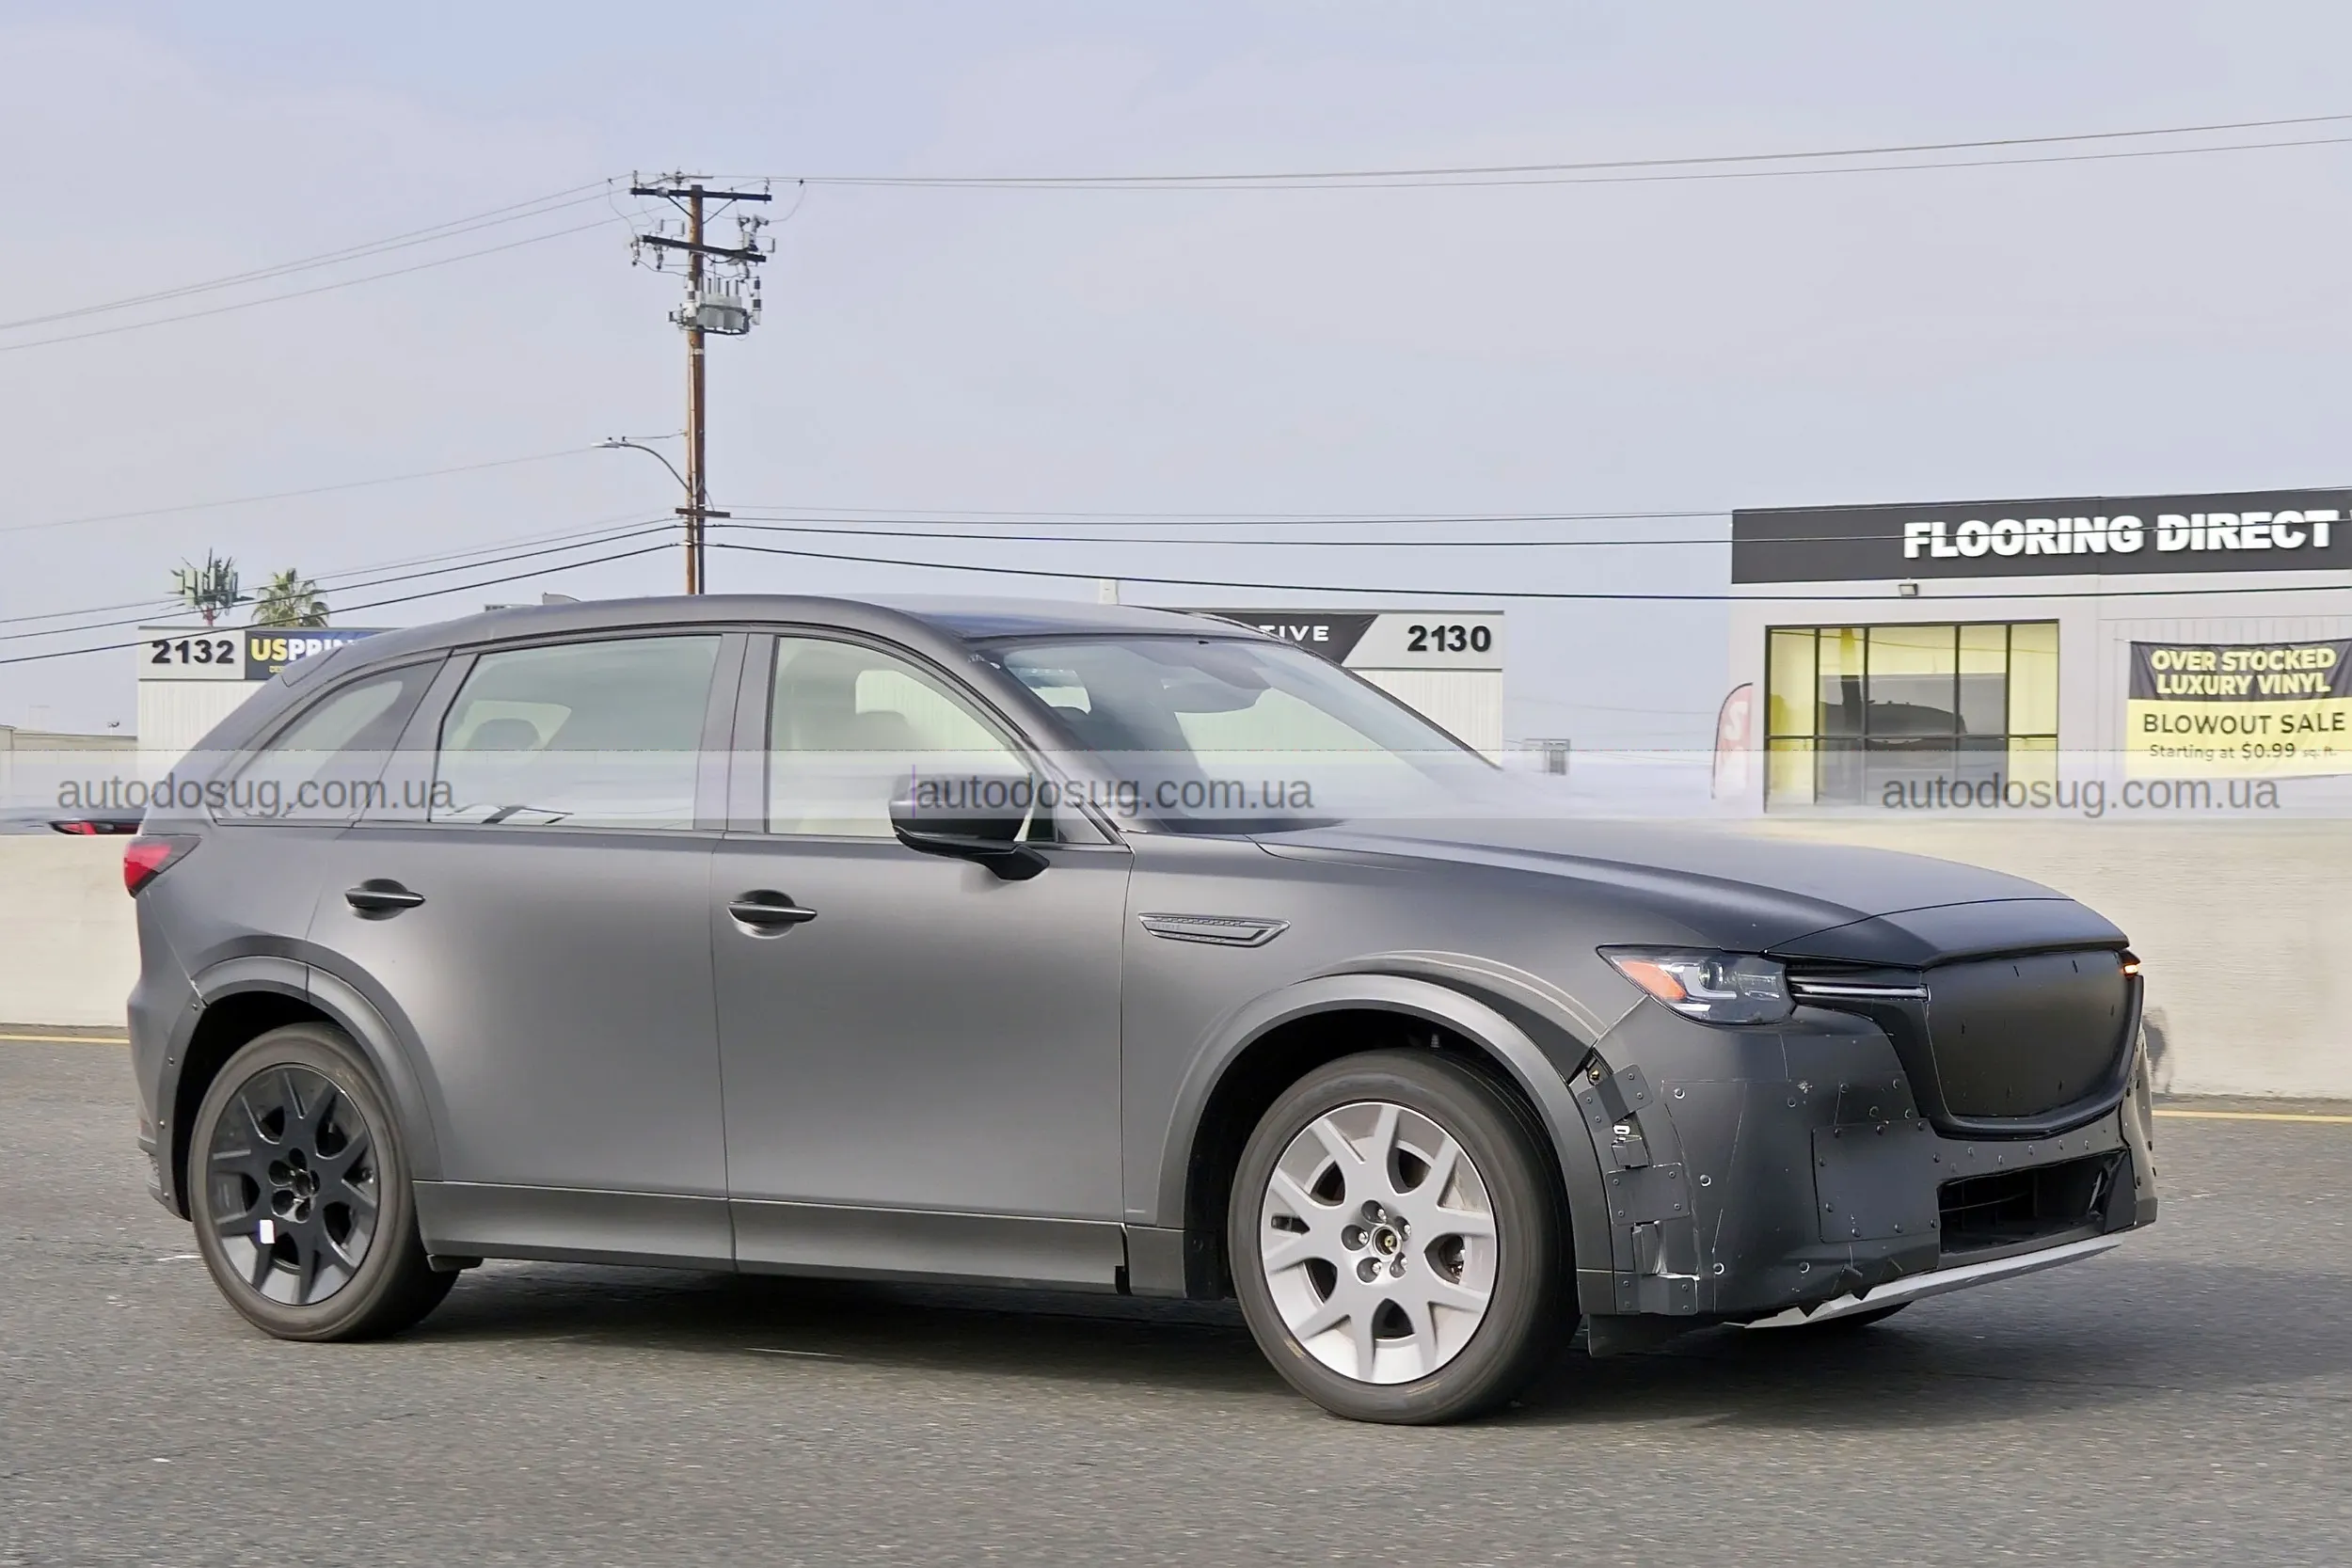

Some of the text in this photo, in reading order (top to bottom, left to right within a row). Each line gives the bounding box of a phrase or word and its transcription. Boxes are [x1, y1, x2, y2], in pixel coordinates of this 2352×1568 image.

[1904, 510, 2340, 559] FLOORING DIRECT
[1406, 625, 1491, 652] 2130
[151, 640, 234, 664] 2132
[2151, 648, 2337, 671] OVER STOCKED
[2156, 673, 2331, 695] LUXURY VINYL
[2143, 712, 2345, 735] BLOWOUT SALE
[2150, 744, 2215, 761] Starting
[2219, 747, 2234, 759] at
[2241, 742, 2296, 762] $0.99
